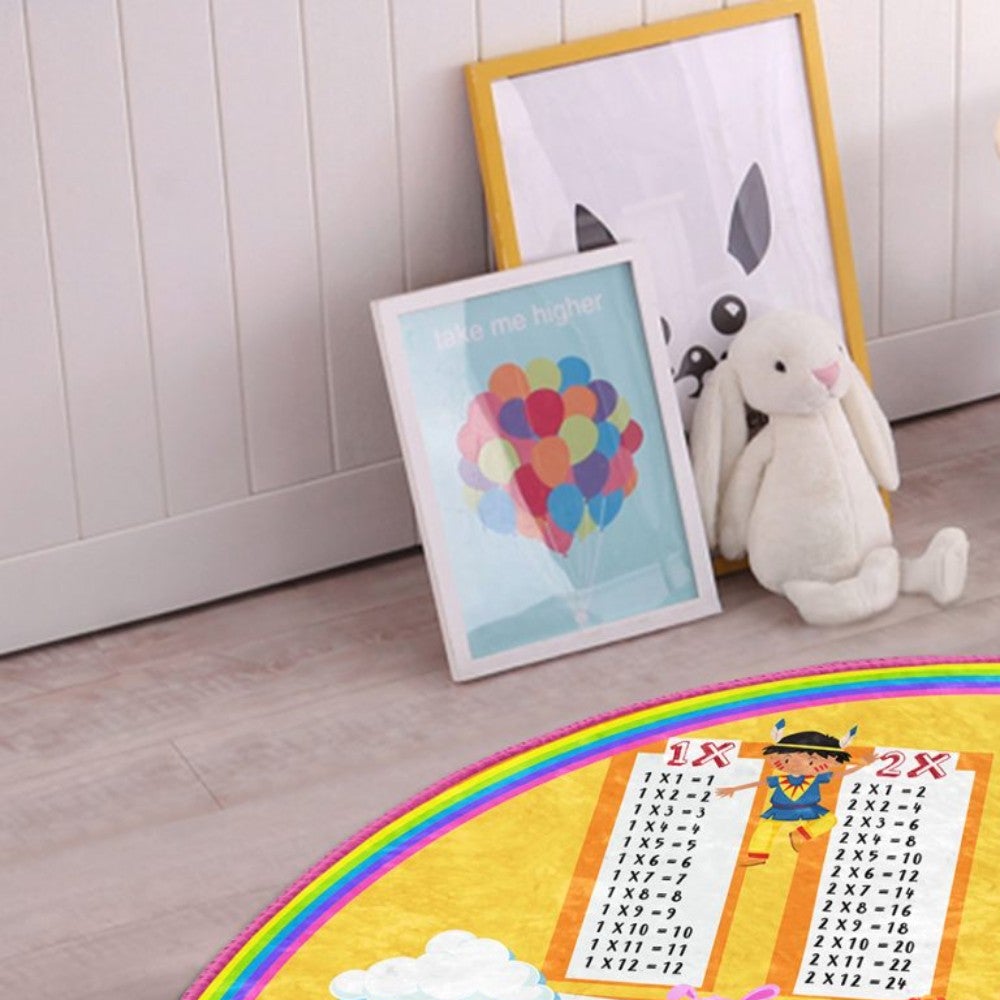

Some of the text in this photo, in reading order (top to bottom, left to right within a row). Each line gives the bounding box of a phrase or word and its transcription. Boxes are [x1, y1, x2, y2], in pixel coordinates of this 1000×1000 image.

[491, 313, 526, 336] me
[533, 294, 602, 326] higher
[629, 820, 637, 831] 1
[692, 824, 700, 834] 4
[835, 848, 845, 860] 2
[903, 852, 922, 865] 10
[585, 956, 593, 968] 1
[663, 961, 683, 974] 12
[809, 953, 820, 966] 2
[889, 958, 911, 972] 22
